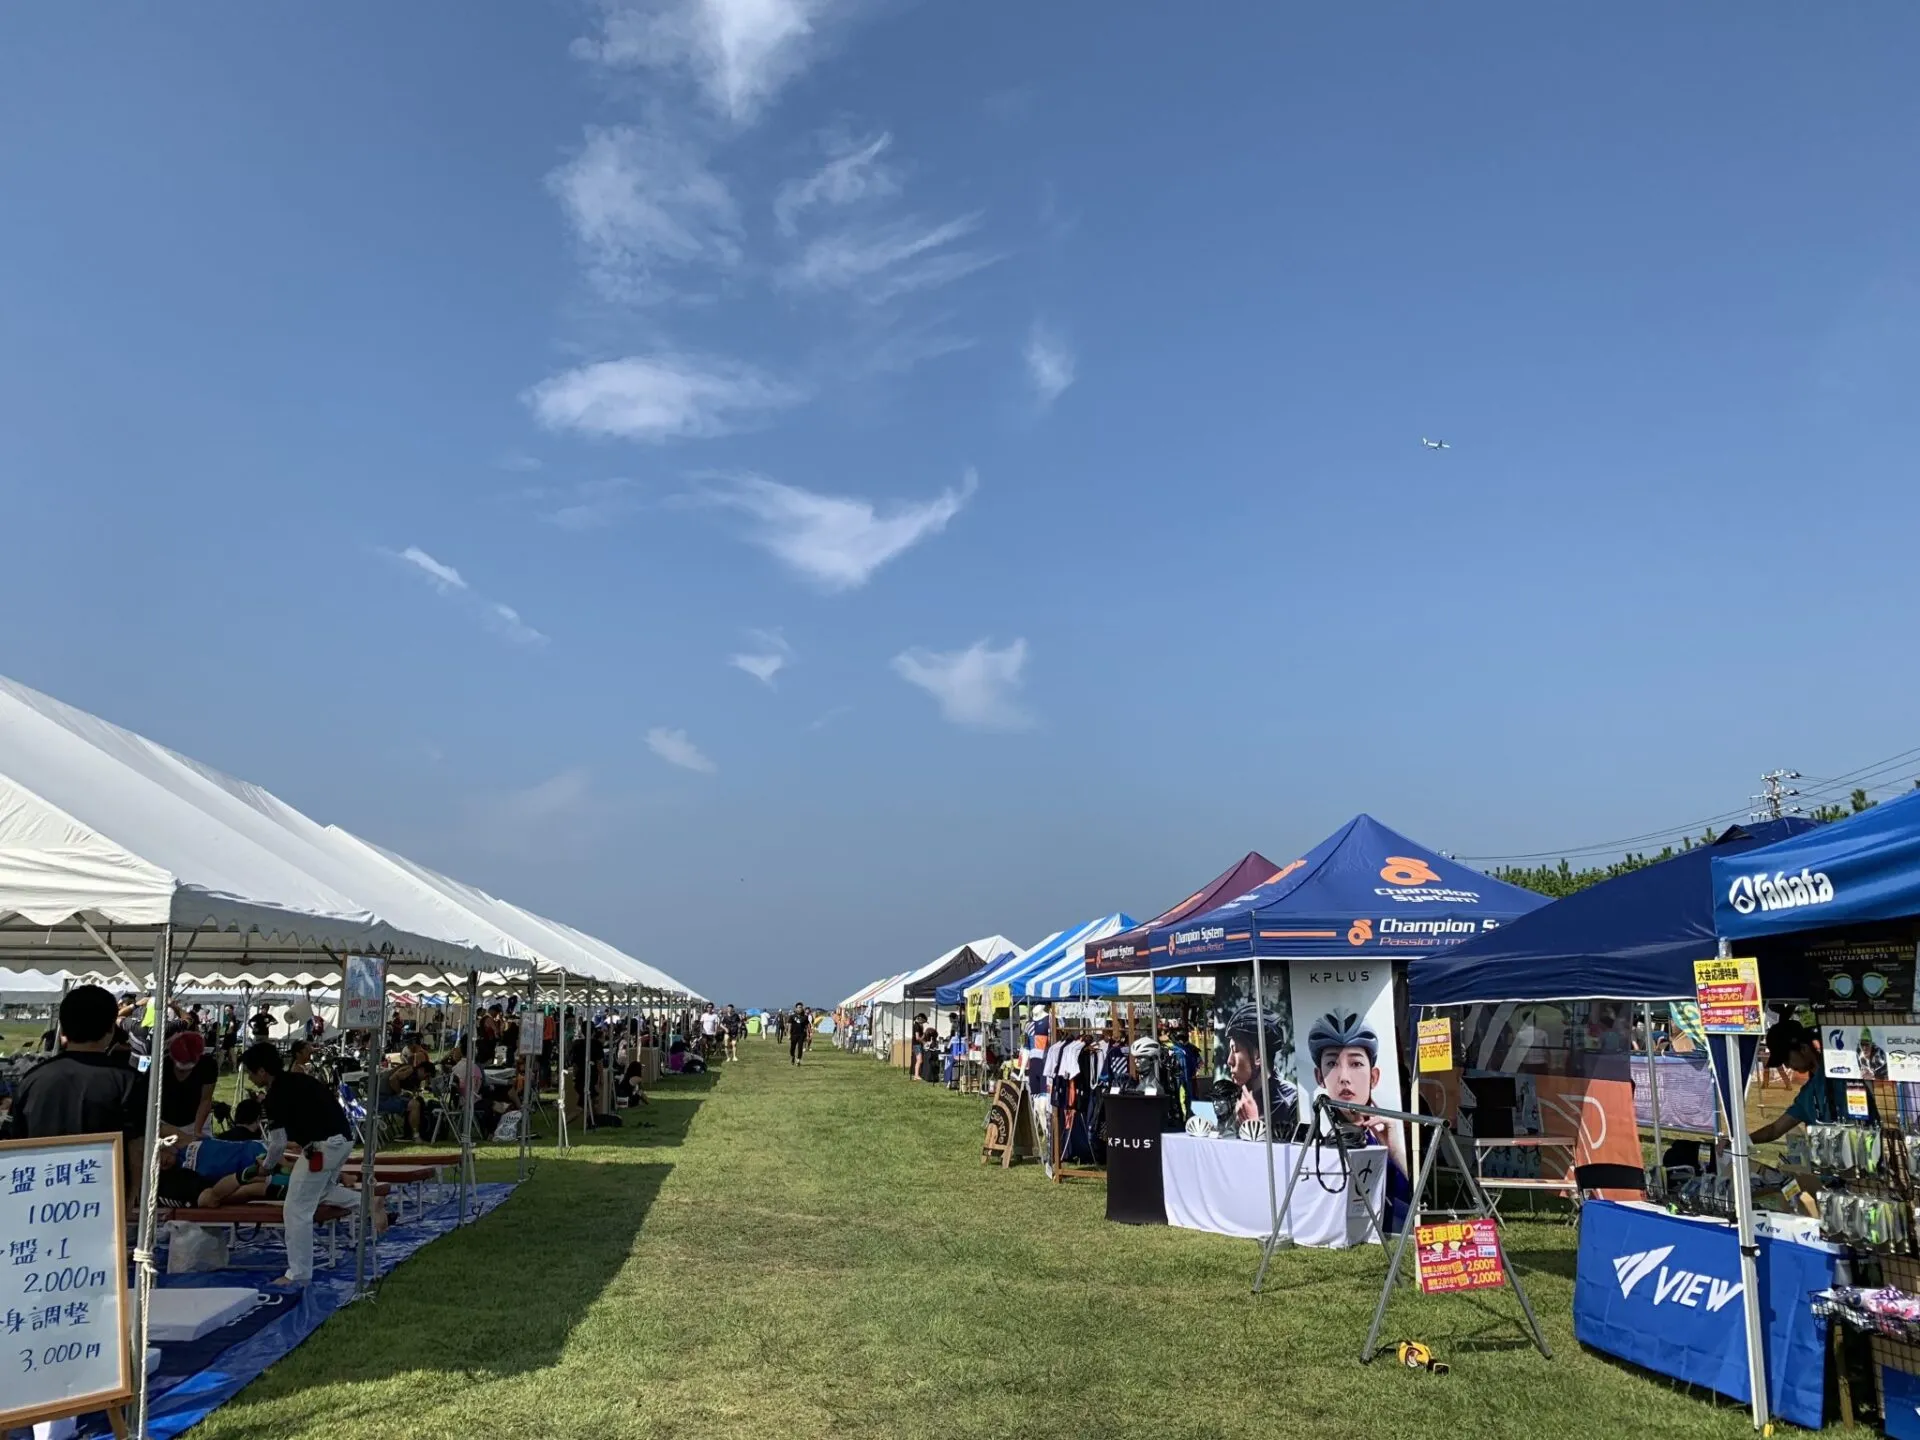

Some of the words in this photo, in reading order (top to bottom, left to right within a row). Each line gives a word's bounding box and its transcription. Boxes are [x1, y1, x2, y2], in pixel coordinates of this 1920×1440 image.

[1374, 887, 1480, 898] Champion
[1753, 868, 1834, 911] Tabata
[1392, 894, 1479, 904] System
[1175, 930, 1201, 945] Champion
[1201, 926, 1225, 943] System
[1379, 918, 1476, 936] Champion
[1379, 936, 1440, 946] Passion
[1310, 970, 1370, 983] KPLUS
[1887, 1036, 1920, 1045] DELAN
[1108, 1137, 1151, 1149] KPLUS
[0, 1159, 102, 1195] 盤調整
[29, 1200, 100, 1224] 1000円
[1417, 1223, 1474, 1245] 在庫限り
[1421, 1249, 1477, 1263] DELANA
[1653, 1265, 1746, 1313] VIEW
[0, 1302, 90, 1335] 身調整
